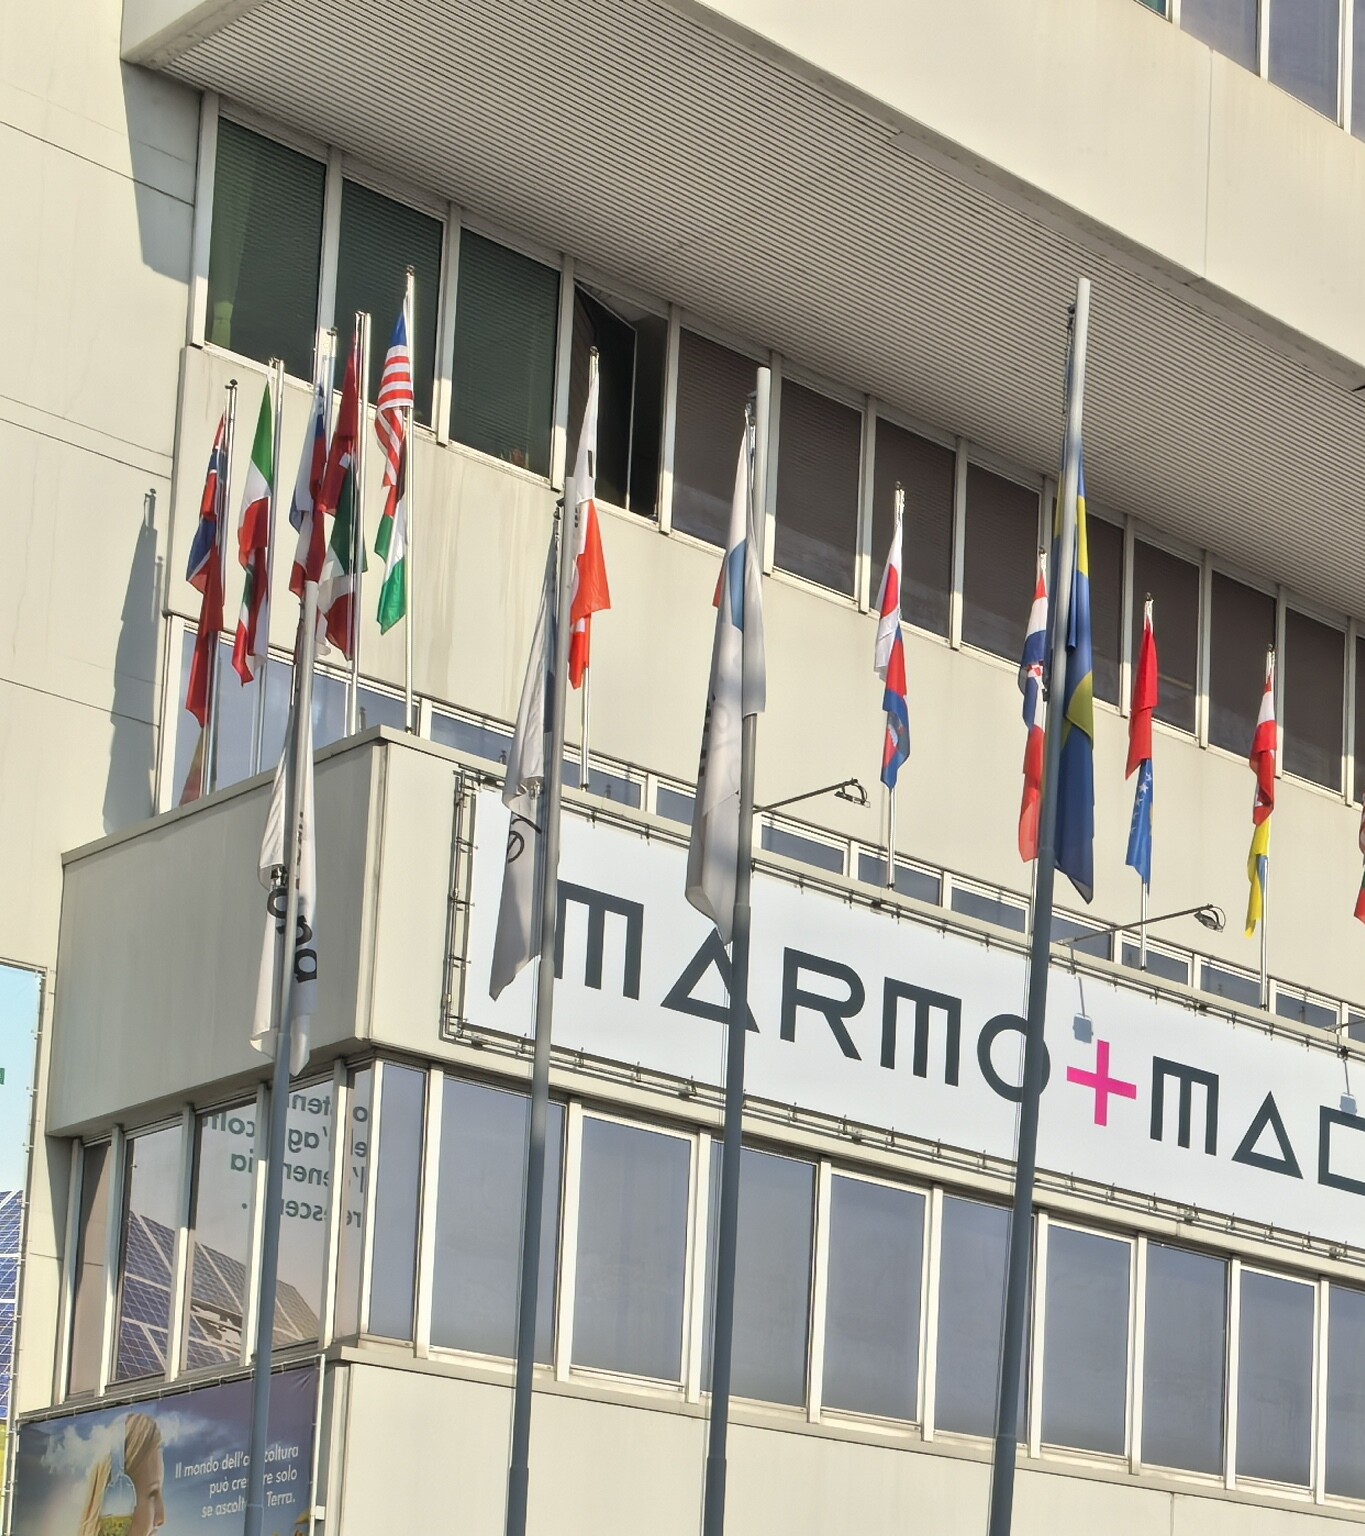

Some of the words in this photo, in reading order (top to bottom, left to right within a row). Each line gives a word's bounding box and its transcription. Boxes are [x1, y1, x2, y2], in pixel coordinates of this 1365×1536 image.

[184, 1456, 219, 1476] mondo
[209, 1476, 229, 1498] può
[276, 1464, 297, 1483] solo
[201, 1504, 213, 1518] se
[215, 1495, 247, 1515] ascolt
